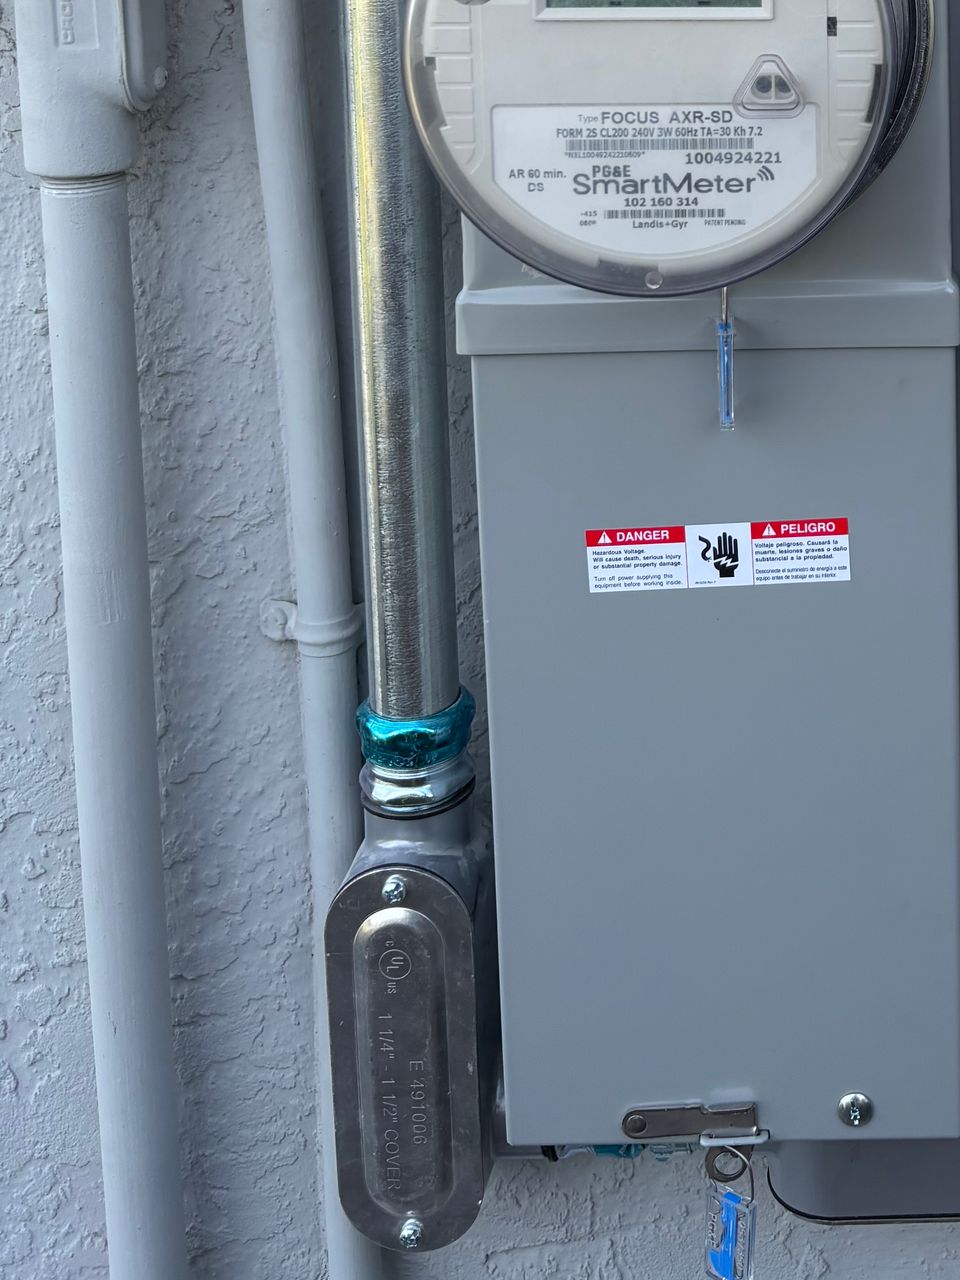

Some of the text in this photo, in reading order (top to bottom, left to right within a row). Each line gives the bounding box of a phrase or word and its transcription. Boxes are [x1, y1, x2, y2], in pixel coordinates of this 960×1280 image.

[578, 111, 733, 124] Type FOCUS AXR-SD
[557, 127, 763, 138] FORM 2S CL200 240V 3W 60Hz TA=30 Kh 7.2
[685, 152, 782, 164] 1004924221
[509, 169, 567, 178] AR 60 min.
[592, 165, 631, 177] PG&E
[528, 182, 544, 192] DS
[573, 172, 757, 195] SmartMeter
[624, 197, 698, 207] 102 160 314
[633, 220, 689, 229] Landis+Gyr
[780, 522, 836, 534] PELIGRO
[616, 530, 670, 542] DANGER
[408, 1060, 427, 1144] E 491006
[383, 1129, 401, 1190] COVER
